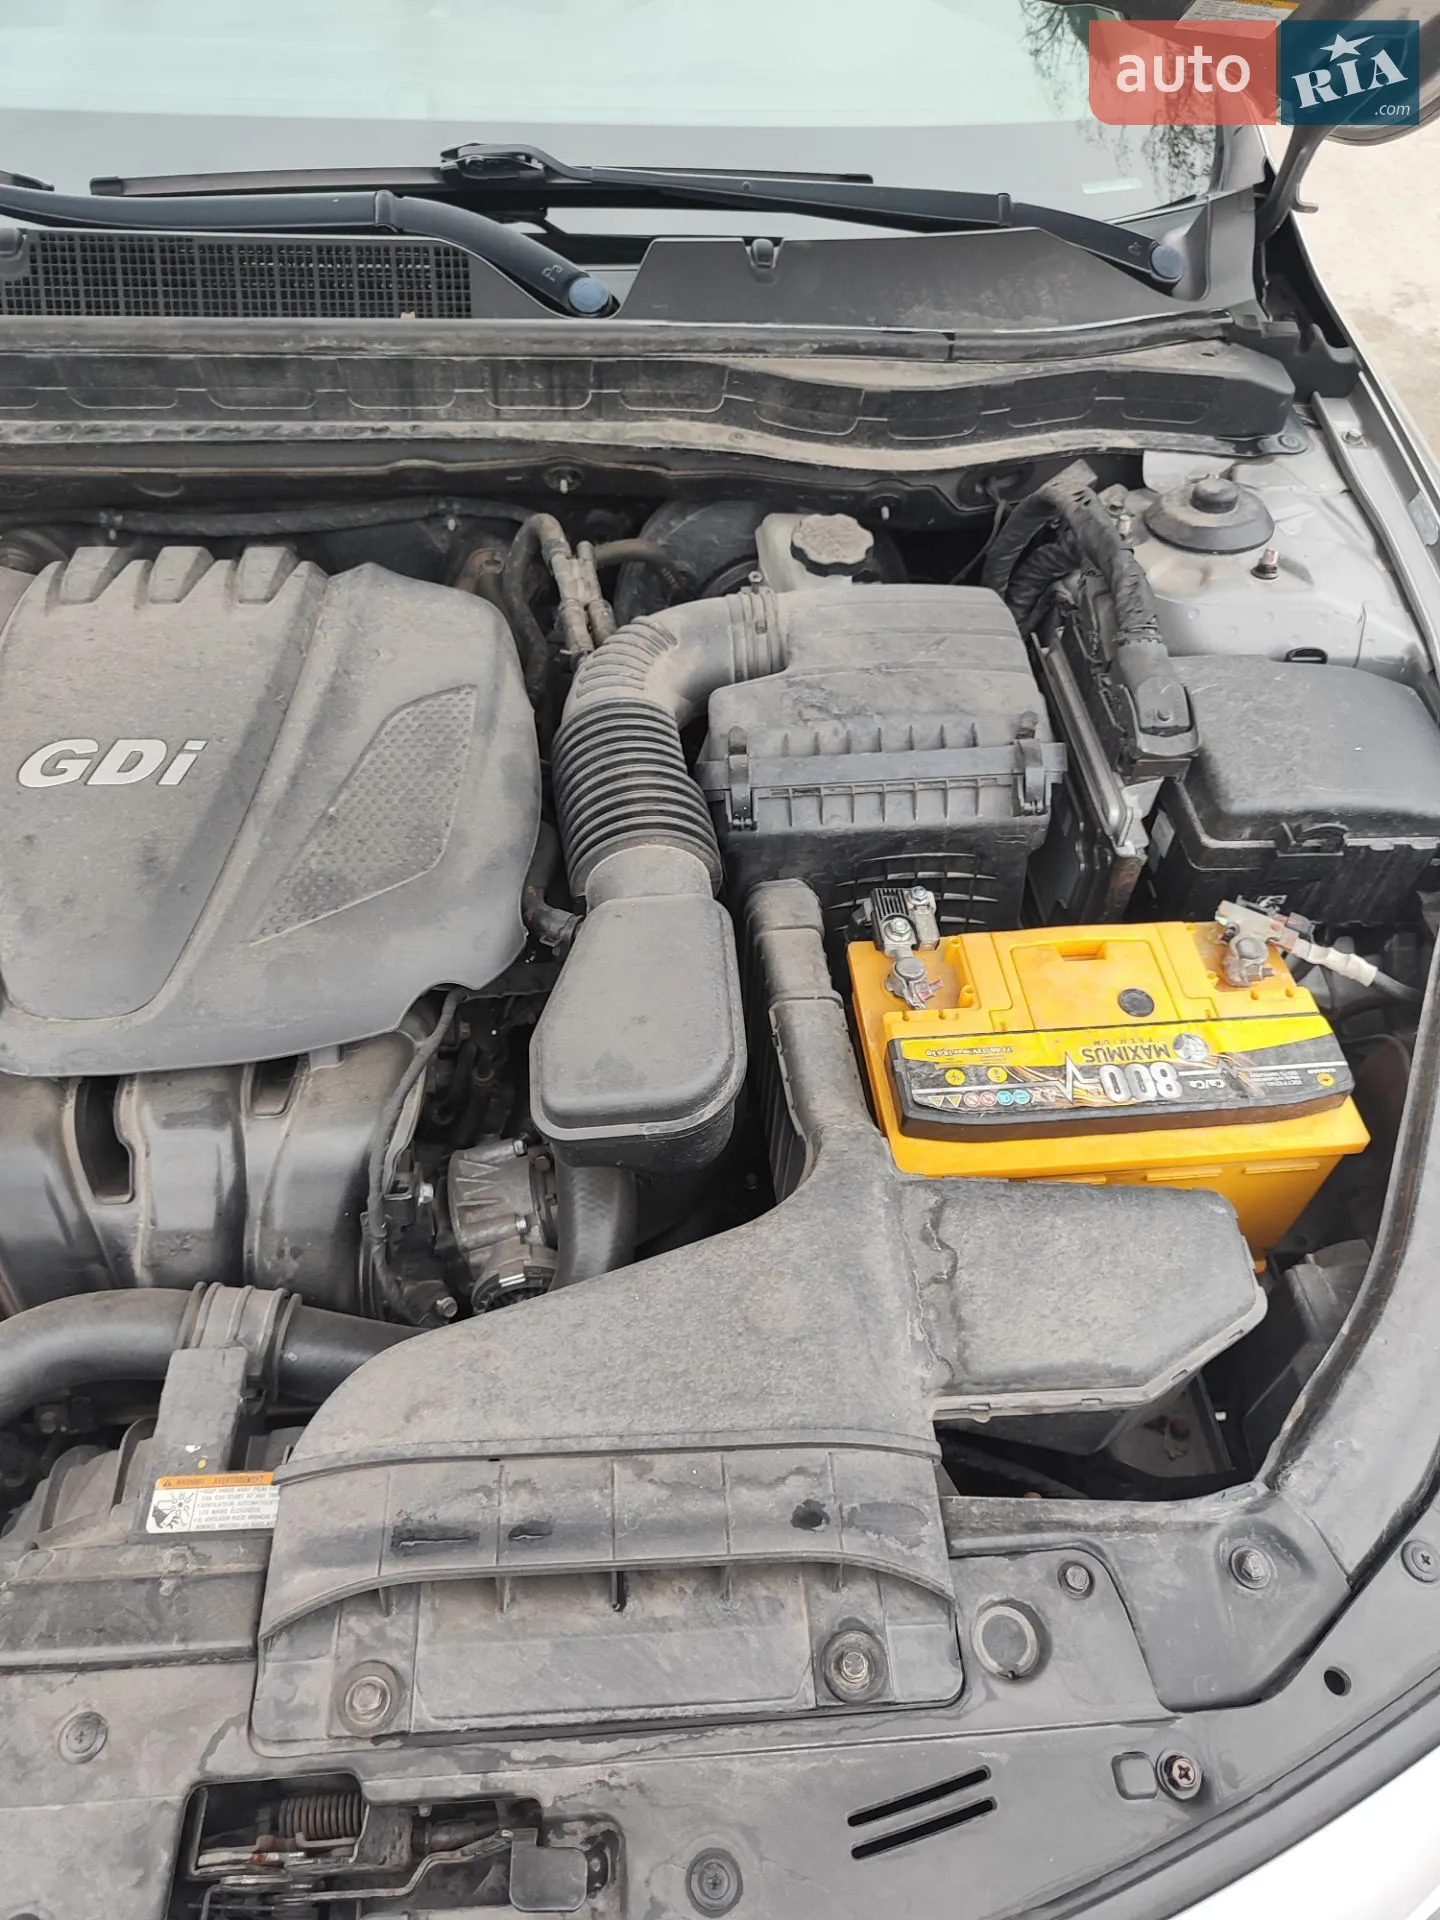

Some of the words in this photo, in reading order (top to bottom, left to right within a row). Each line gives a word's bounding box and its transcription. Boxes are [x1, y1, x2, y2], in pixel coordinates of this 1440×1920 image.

[18, 738, 208, 788] GDi
[1082, 1043, 1171, 1063] MAXIMUS
[1101, 1061, 1184, 1103] 800
